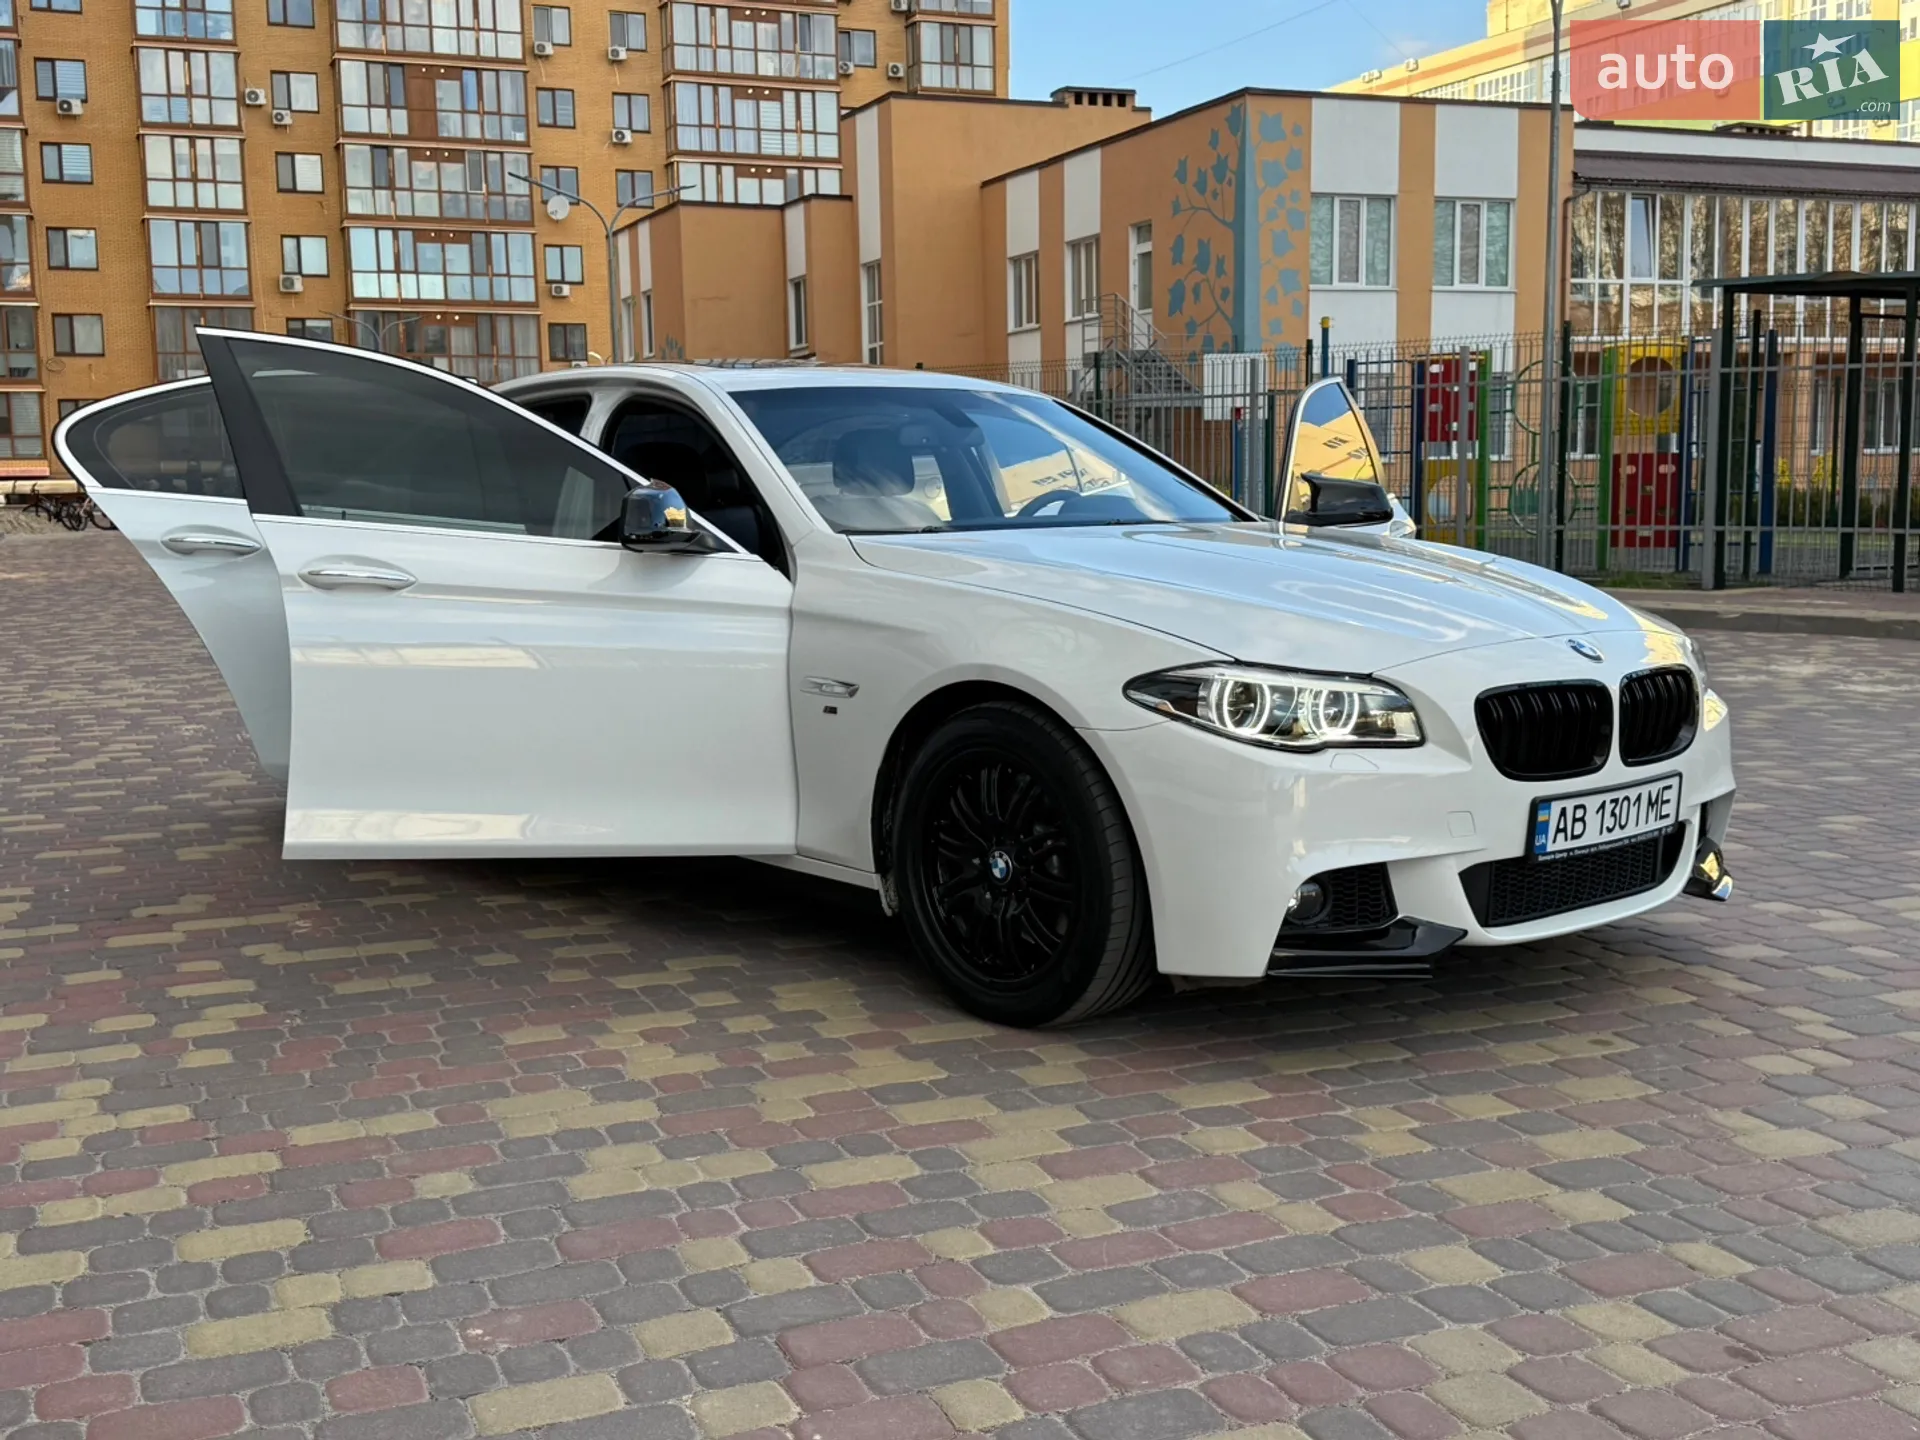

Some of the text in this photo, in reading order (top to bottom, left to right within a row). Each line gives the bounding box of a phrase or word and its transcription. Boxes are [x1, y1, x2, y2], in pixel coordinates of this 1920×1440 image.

[1552, 784, 1673, 844] AB 1301 ME
[1535, 833, 1547, 846] UA
